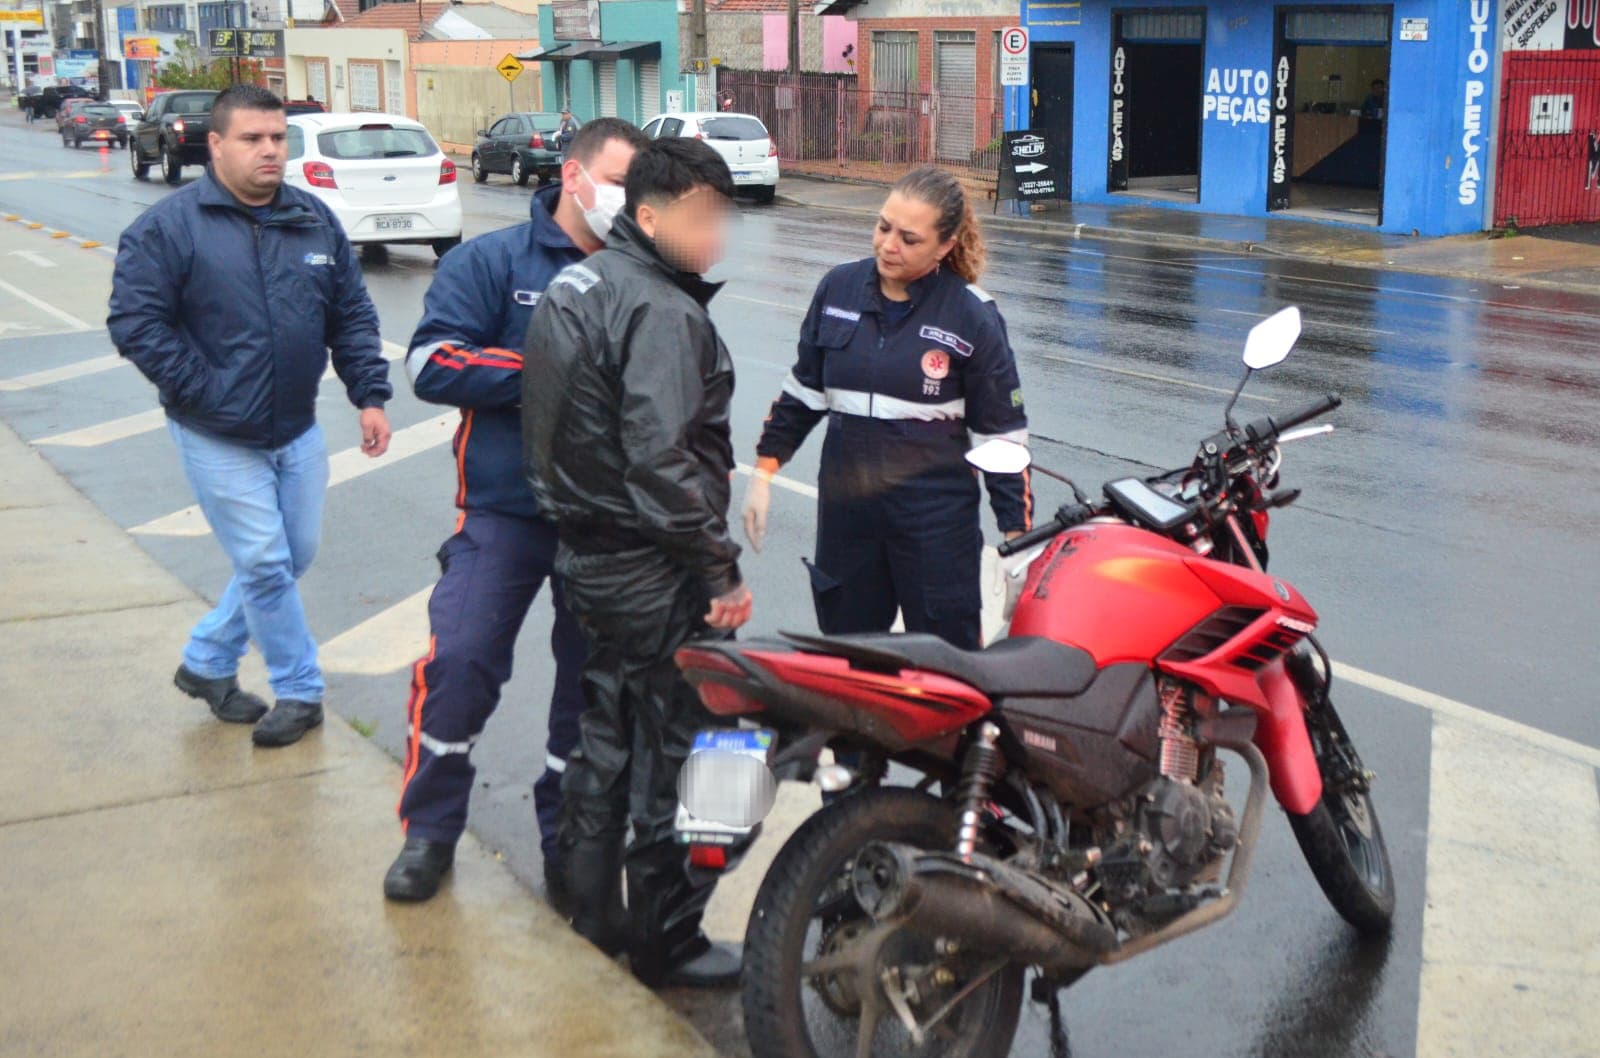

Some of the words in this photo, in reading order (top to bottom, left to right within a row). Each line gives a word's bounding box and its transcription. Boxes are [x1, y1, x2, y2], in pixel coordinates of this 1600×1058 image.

[1010, 34, 1020, 49] E
[1517, 2, 1558, 48] SUSPENSÃO
[1113, 47, 1125, 95] AUTO
[1207, 68, 1269, 96] AUTO
[1276, 56, 1289, 110] AUTO
[1112, 99, 1125, 161] PEÇAS
[1203, 95, 1271, 126] PEÇAS
[1011, 141, 1045, 156] SHELBY
[1273, 115, 1287, 183] PEÇAS
[1458, 80, 1484, 206] PEÇAS
[922, 384, 940, 395] 192
